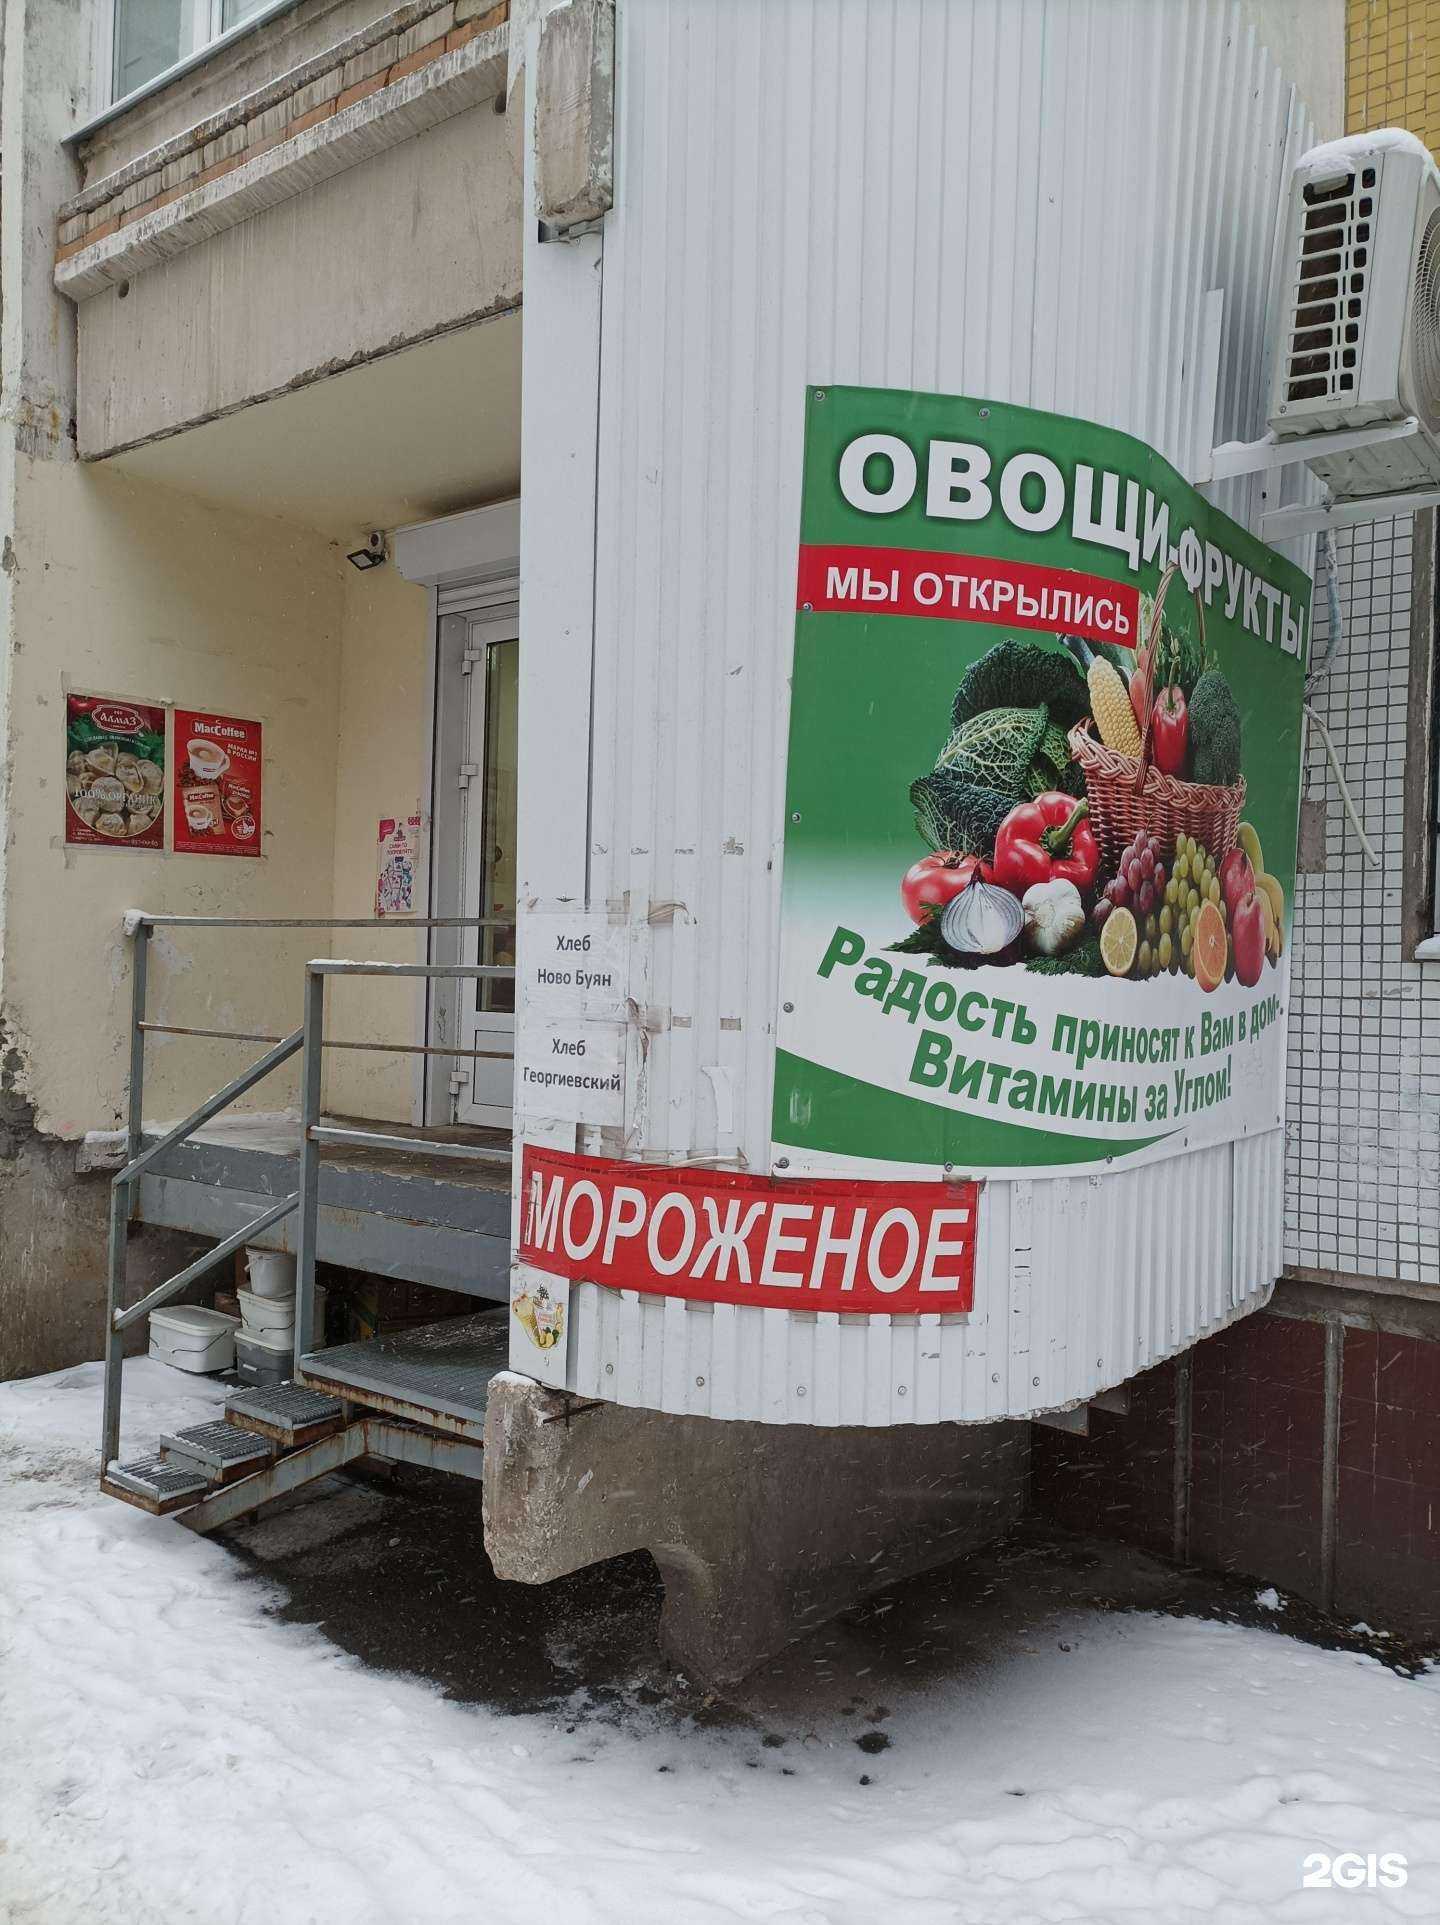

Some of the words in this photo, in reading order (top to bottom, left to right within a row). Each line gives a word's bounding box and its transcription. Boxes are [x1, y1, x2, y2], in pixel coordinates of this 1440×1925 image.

[825, 566, 899, 602] МЫ
[913, 572, 1130, 635] ОТКРЫЛИСЬ
[194, 721, 245, 739] MacCoffee
[556, 934, 591, 952] Хлеб
[537, 968, 571, 985] Ново
[575, 969, 612, 989] Буян
[816, 926, 1038, 1045] Радость
[1051, 1013, 1180, 1070] приносят
[1184, 1025, 1195, 1060] к
[1200, 1010, 1234, 1056] Вам
[1238, 1010, 1246, 1042] в
[552, 1038, 586, 1056] Хлеб
[523, 1066, 621, 1092] Георгиевский
[908, 1028, 1138, 1123] Витамины
[1144, 1083, 1168, 1122] за
[1173, 1053, 1232, 1117] Углом!
[523, 1170, 970, 1293] МОРОЖЕНОЕ
